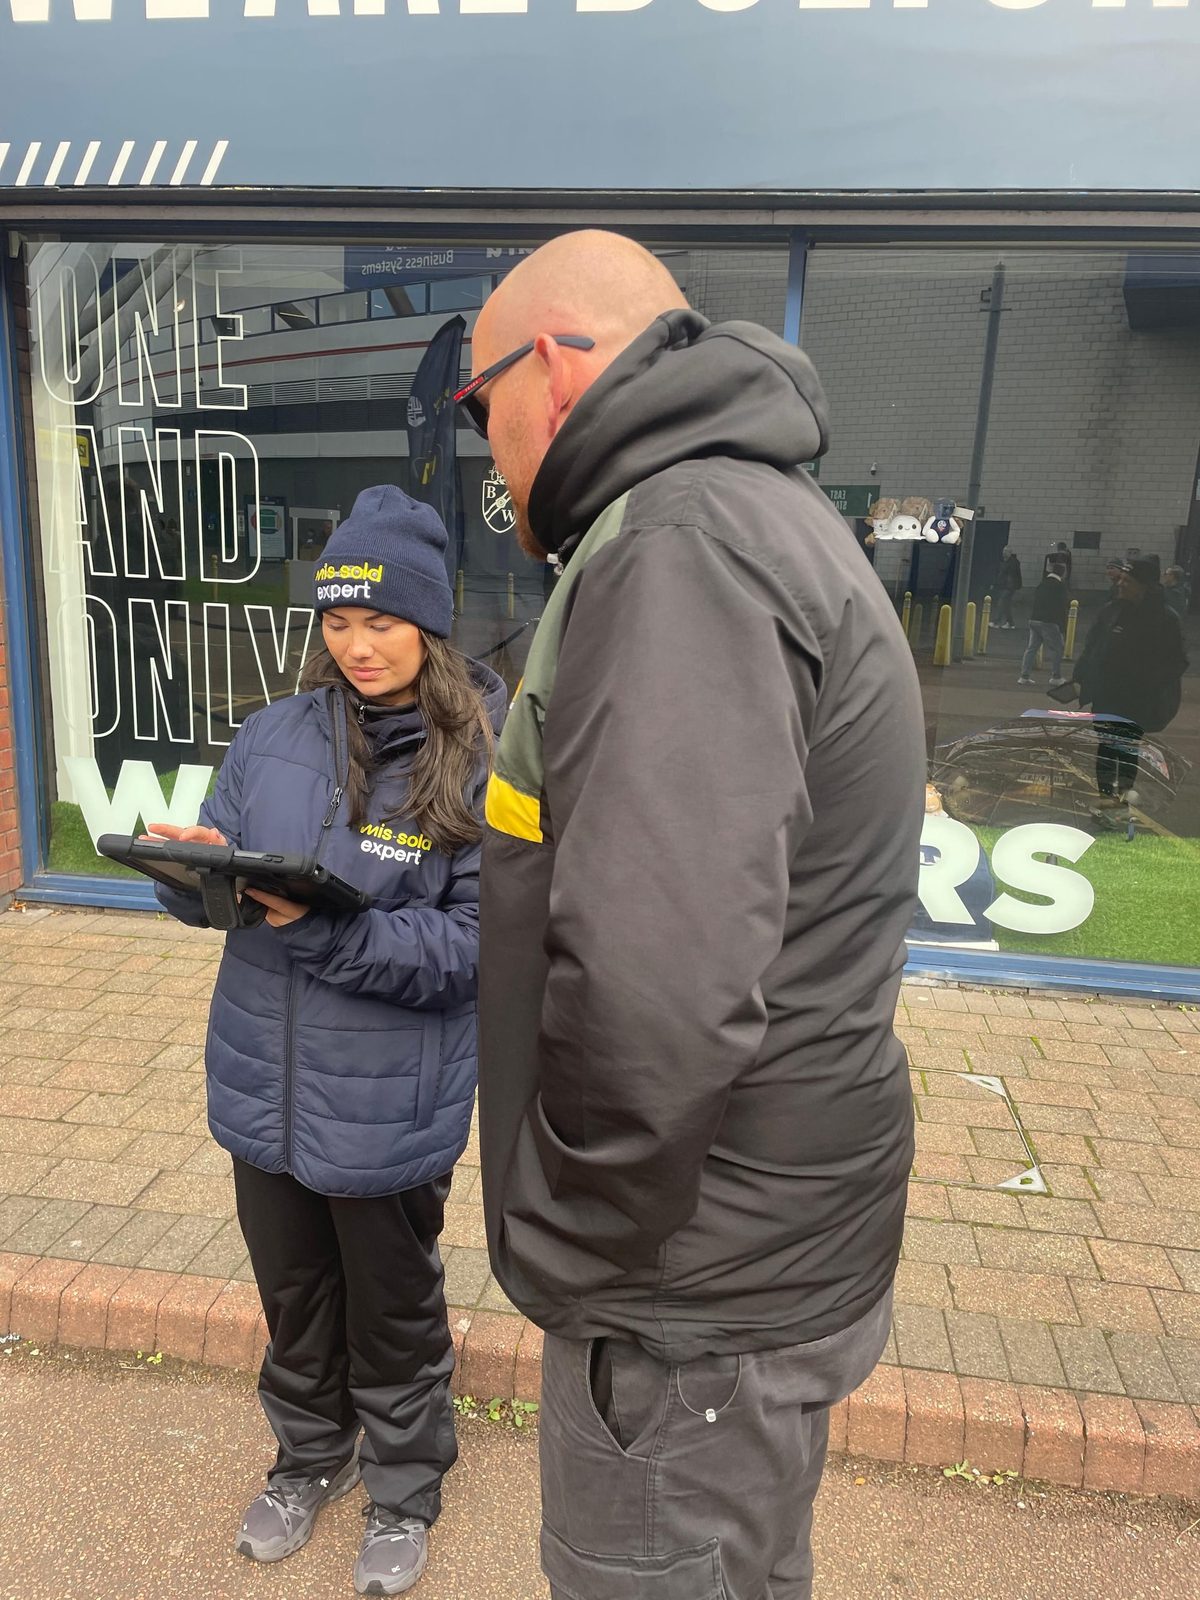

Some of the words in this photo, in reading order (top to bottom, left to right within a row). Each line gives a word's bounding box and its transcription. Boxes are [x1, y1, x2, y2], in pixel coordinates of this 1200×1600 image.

[37, 246, 248, 411] ONE
[49, 424, 261, 583] AND
[317, 581, 371, 601] expert
[360, 840, 421, 865] expert
